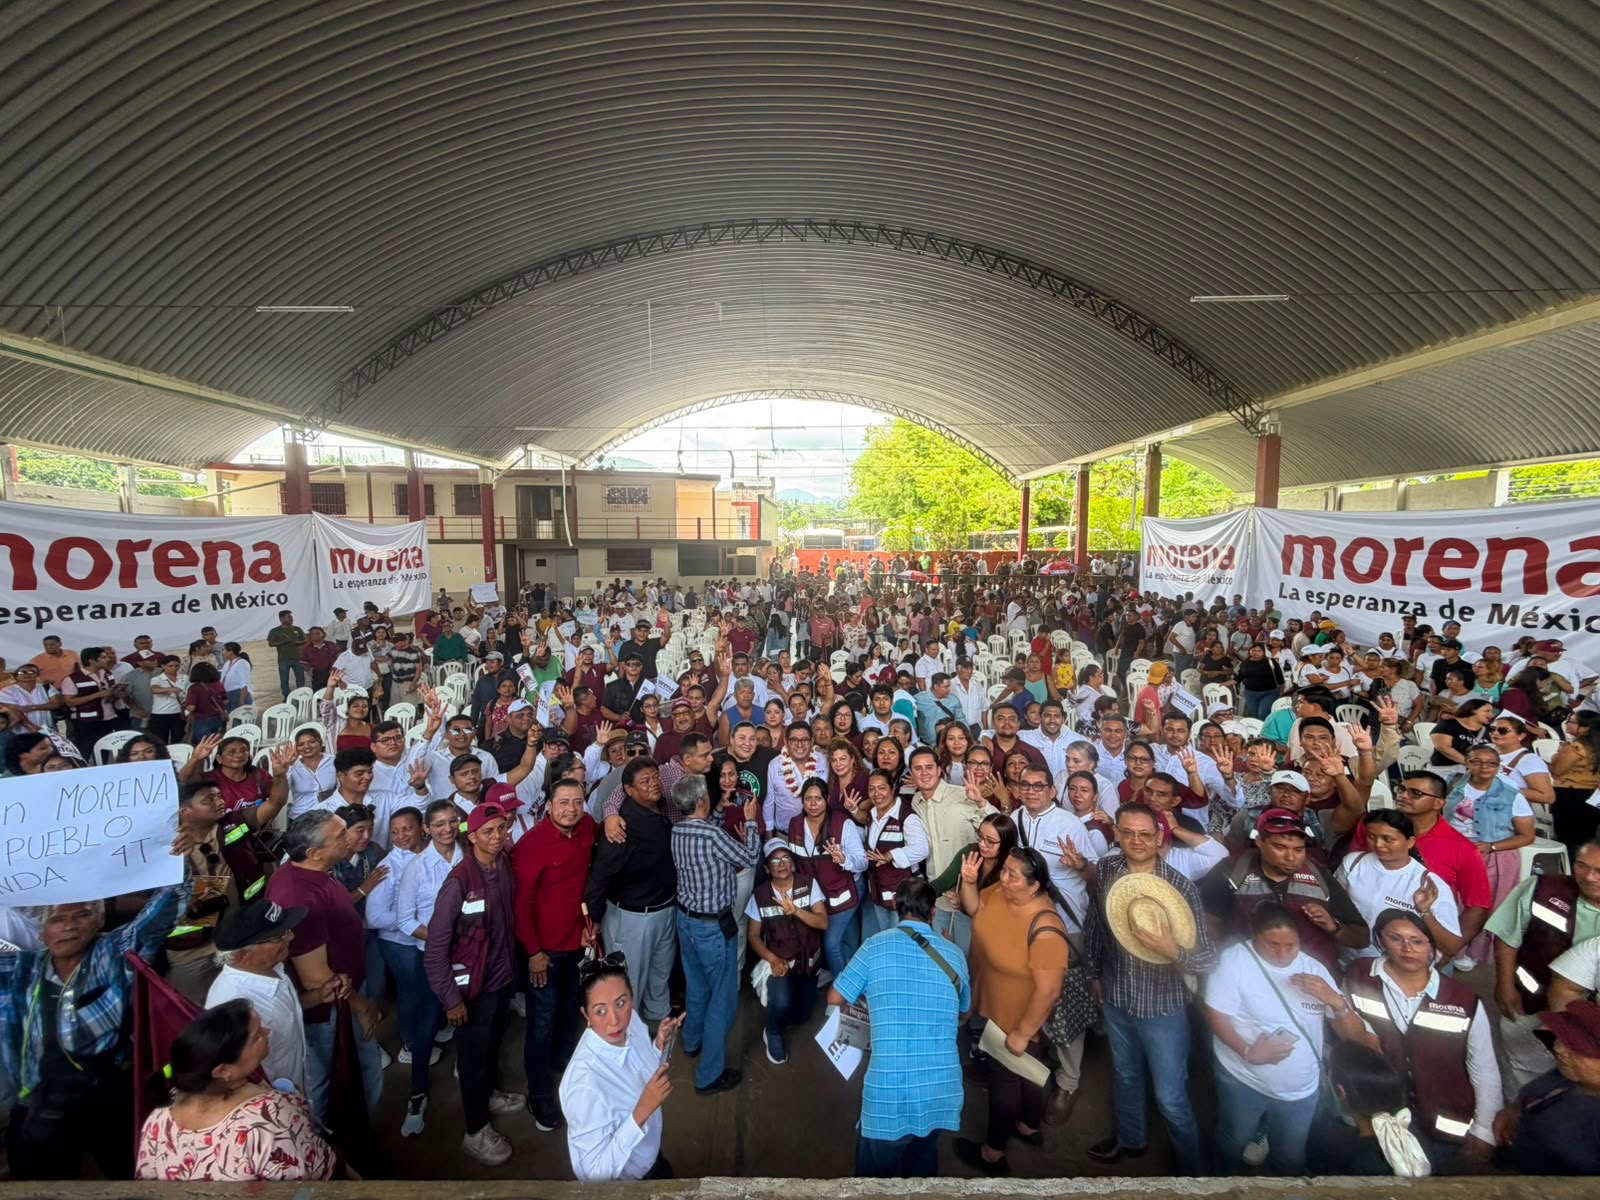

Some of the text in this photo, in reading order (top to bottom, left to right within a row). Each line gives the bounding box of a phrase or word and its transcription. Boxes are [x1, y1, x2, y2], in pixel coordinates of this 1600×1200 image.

[1146, 544, 1236, 570] morena
[1281, 535, 1600, 598] morena
[333, 578, 344, 589] La
[347, 578, 387, 590] esperanza
[1145, 569, 1153, 579] La
[171, 594, 201, 614] de
[210, 590, 288, 611] México
[1278, 582, 1600, 634] La esperanza de Méxic
[1175, 692, 1197, 709] morena
[57, 772, 168, 821] MORENA
[6, 816, 133, 867] PUEBLO
[111, 837, 152, 867] 4T
[1428, 1002, 1465, 1013] morena
